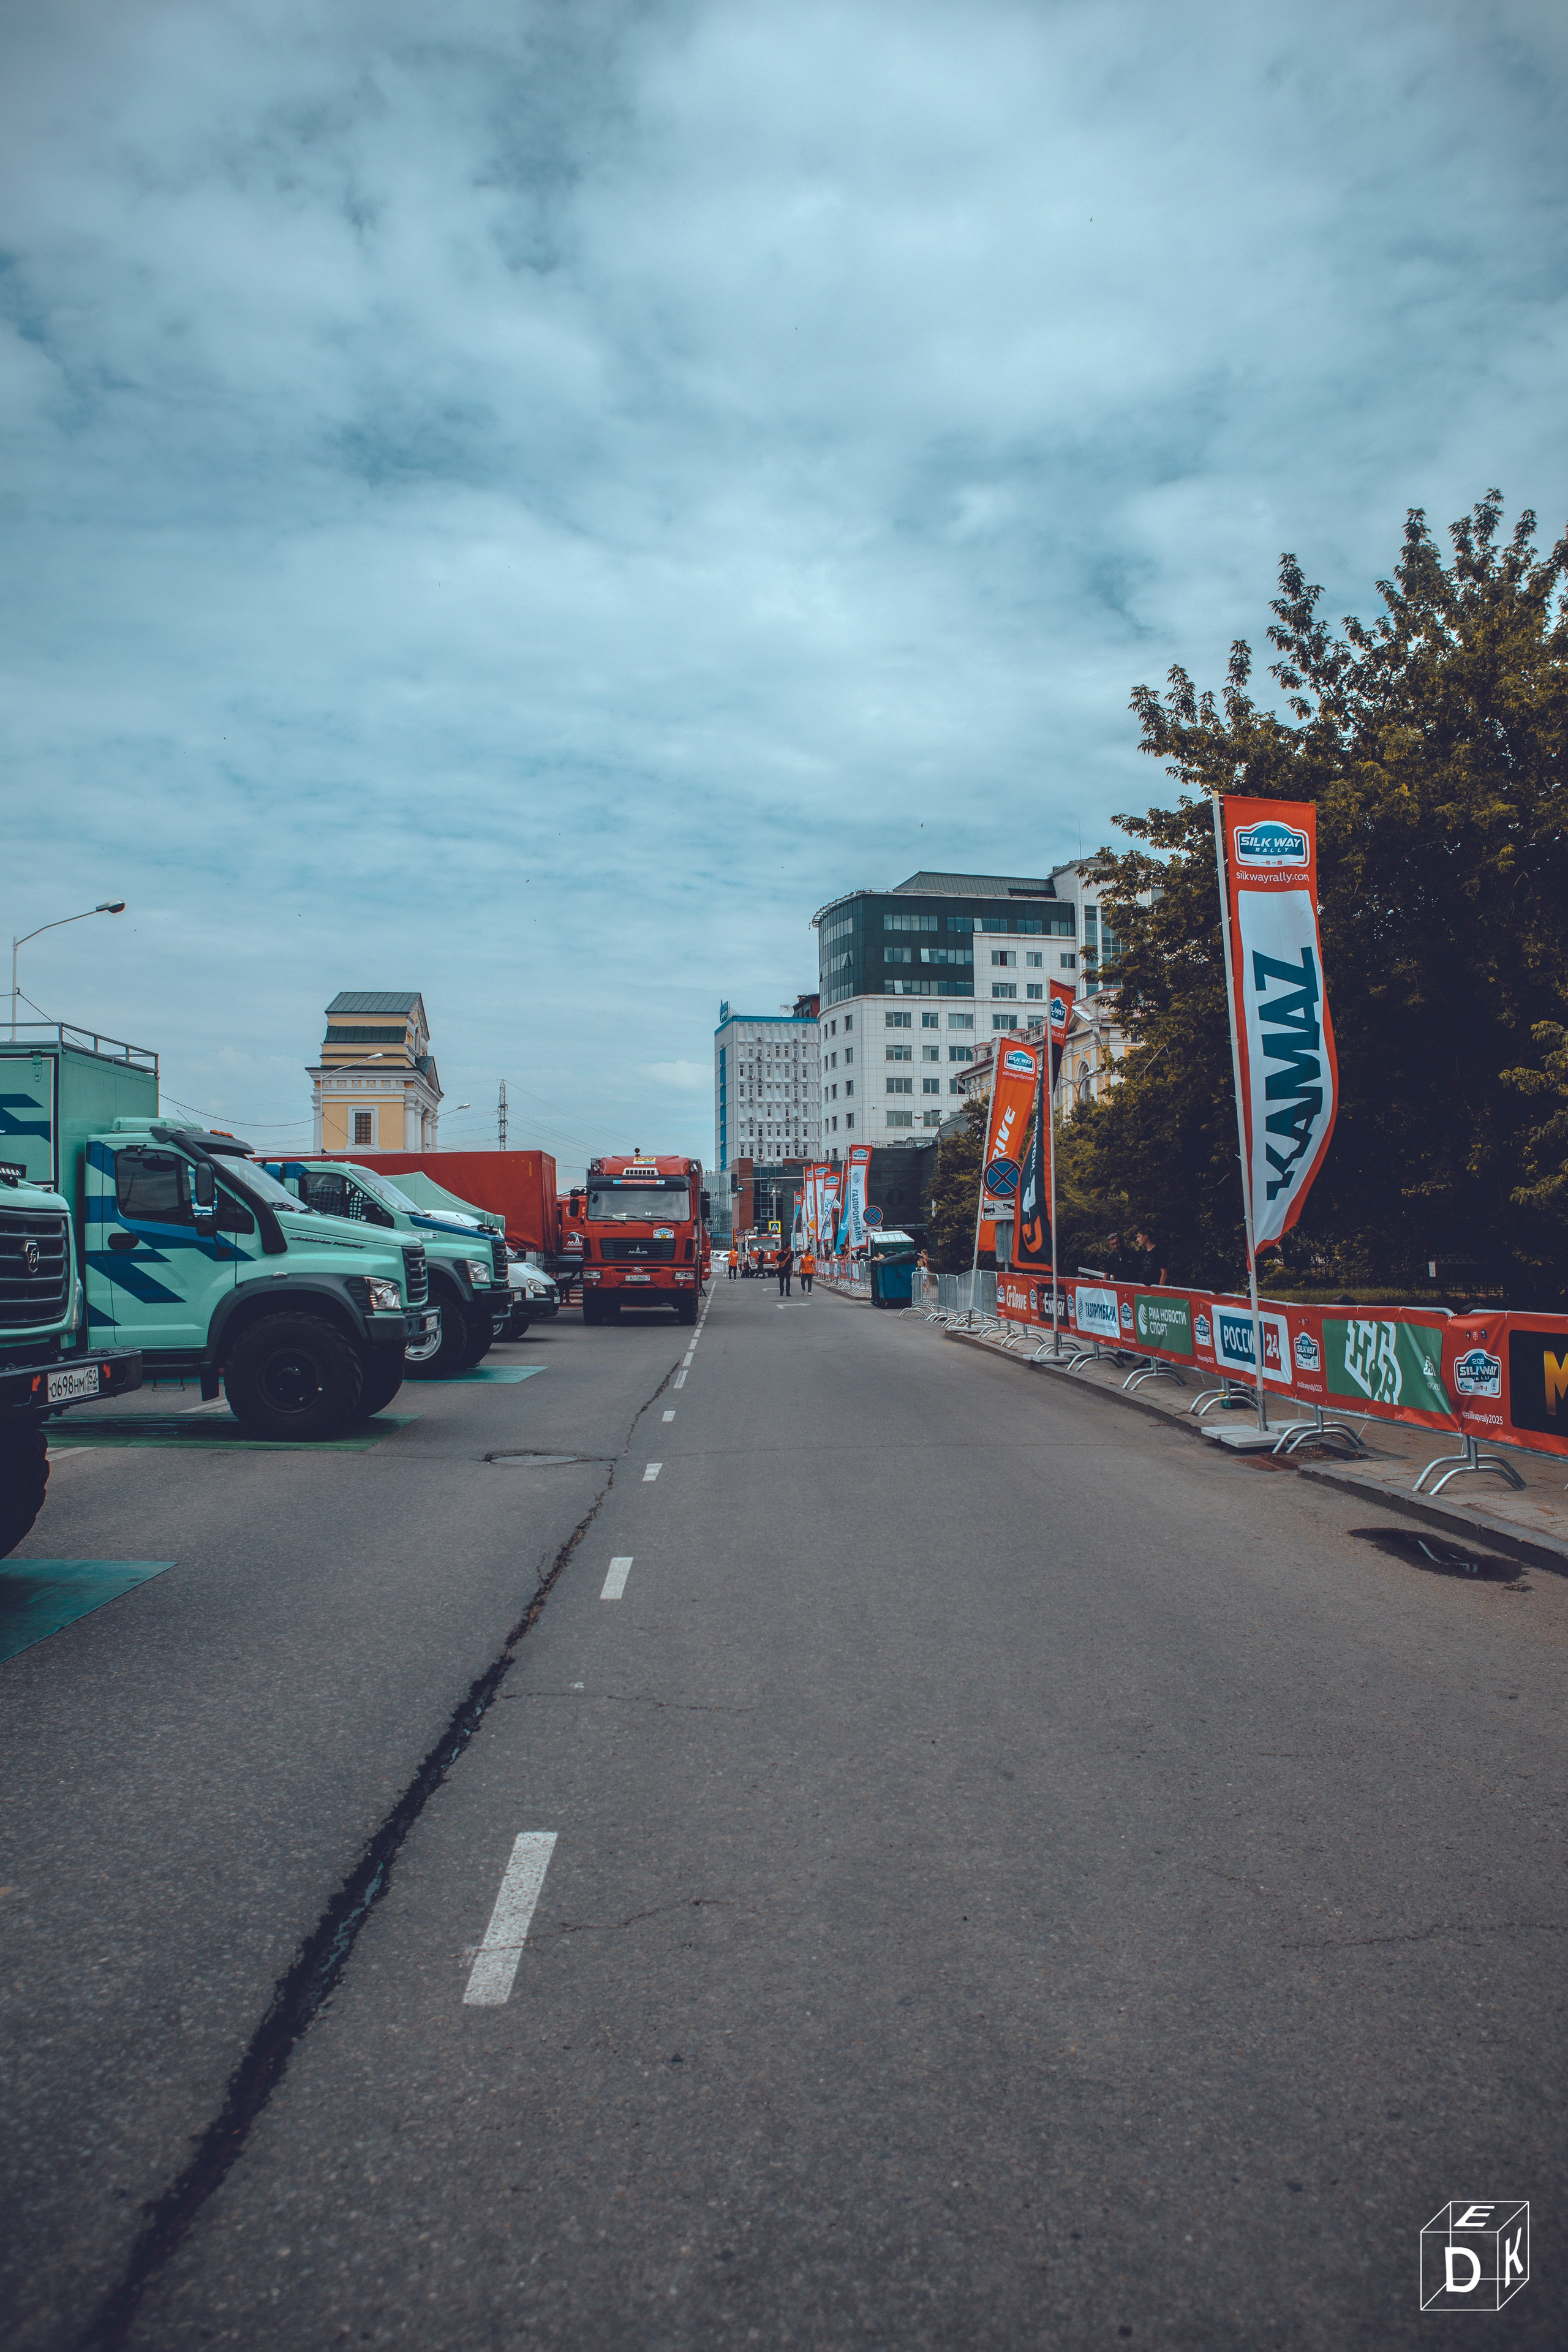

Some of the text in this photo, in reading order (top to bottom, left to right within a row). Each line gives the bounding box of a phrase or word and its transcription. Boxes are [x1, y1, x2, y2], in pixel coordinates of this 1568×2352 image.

[1240, 836, 1302, 848] SILK WAY
[1252, 946, 1323, 1201] KAMAZ
[851, 1189, 862, 1242] ГАЗПРОМБАНК
[1148, 1306, 1186, 1325] РИА НОВОСТИ
[1150, 1322, 1167, 1336] СПОРТ
[1223, 1325, 1279, 1359] РОССИ 24
[86, 1369, 97, 1385] 152
